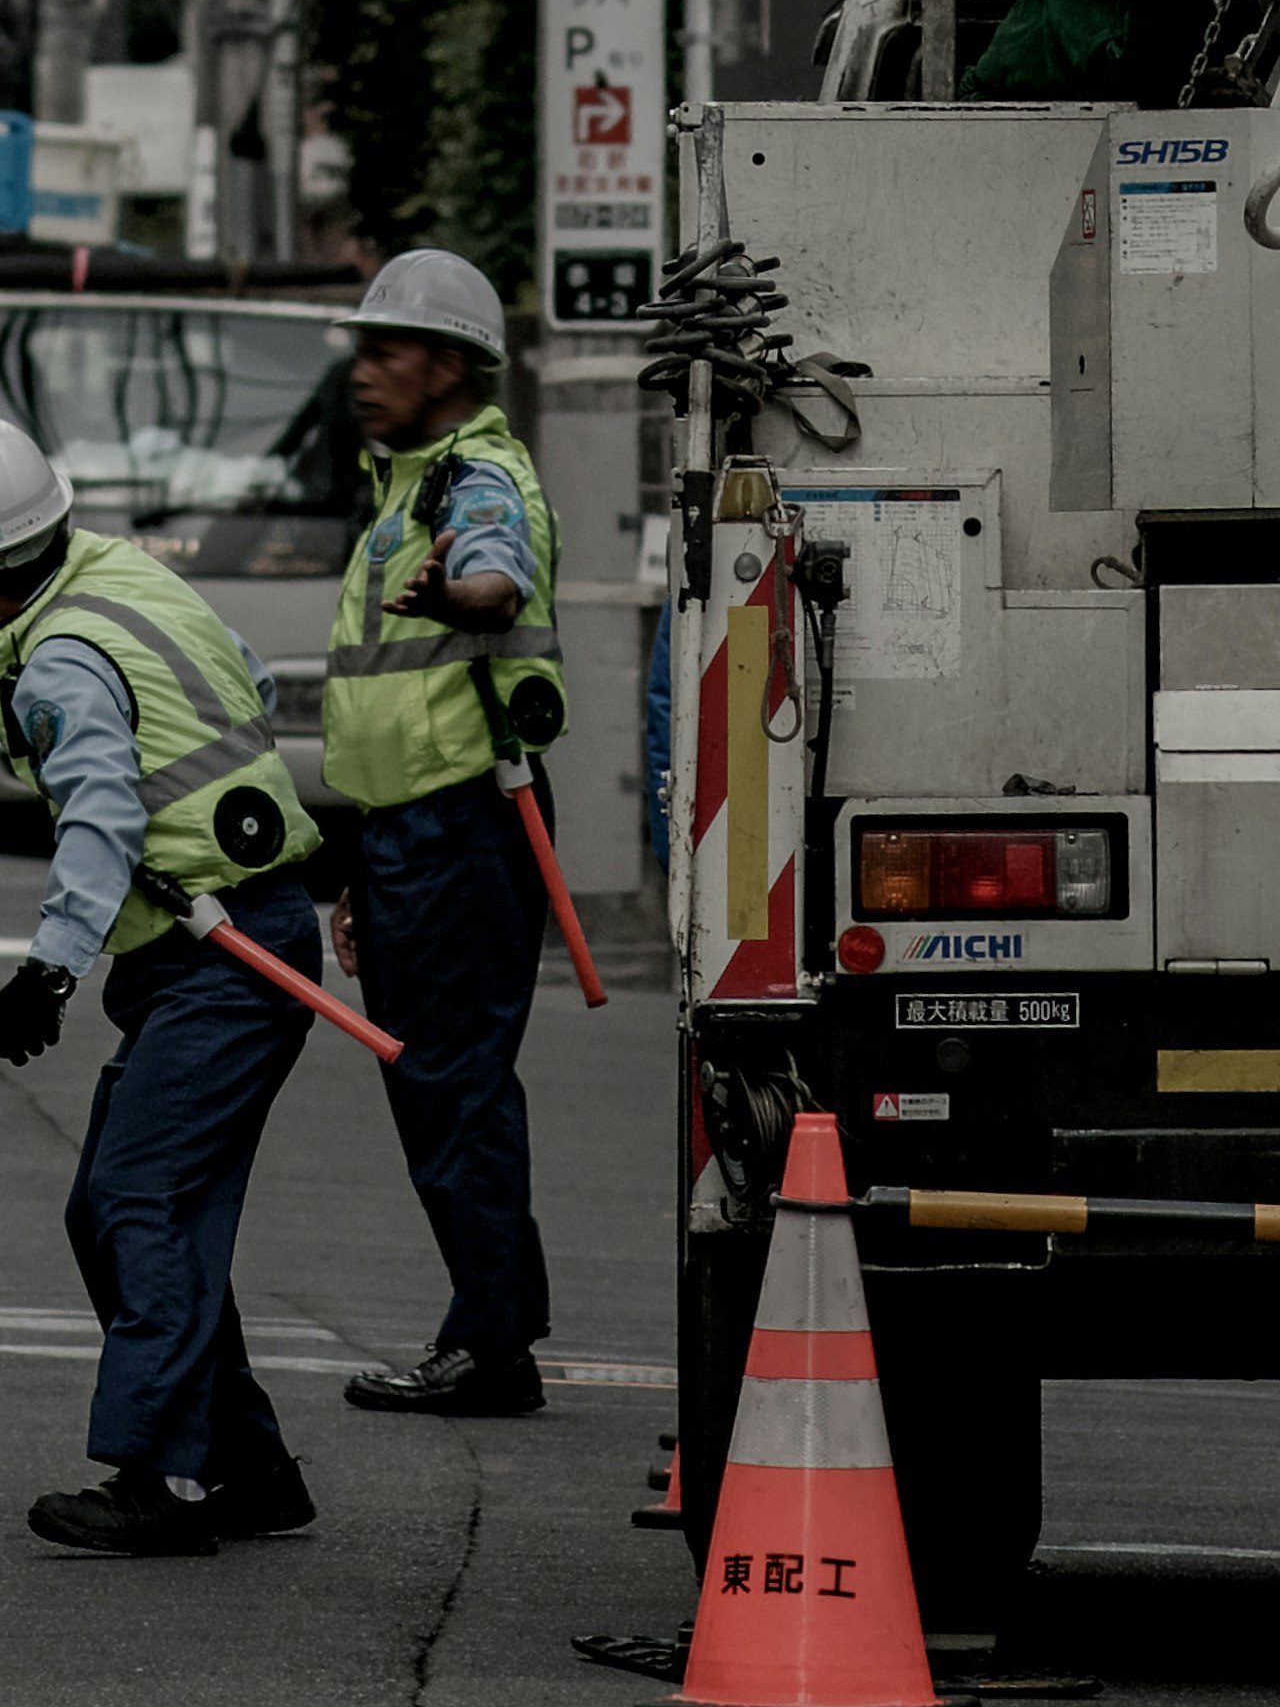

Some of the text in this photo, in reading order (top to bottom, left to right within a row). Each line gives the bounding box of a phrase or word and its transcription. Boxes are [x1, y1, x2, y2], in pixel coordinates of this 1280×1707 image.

[566, 26, 595, 70] P
[1116, 140, 1229, 164] SH15B
[922, 934, 1023, 959] AICHI
[906, 1000, 1071, 1022] 最大積載量 500kg
[721, 1553, 856, 1598] 東配工
